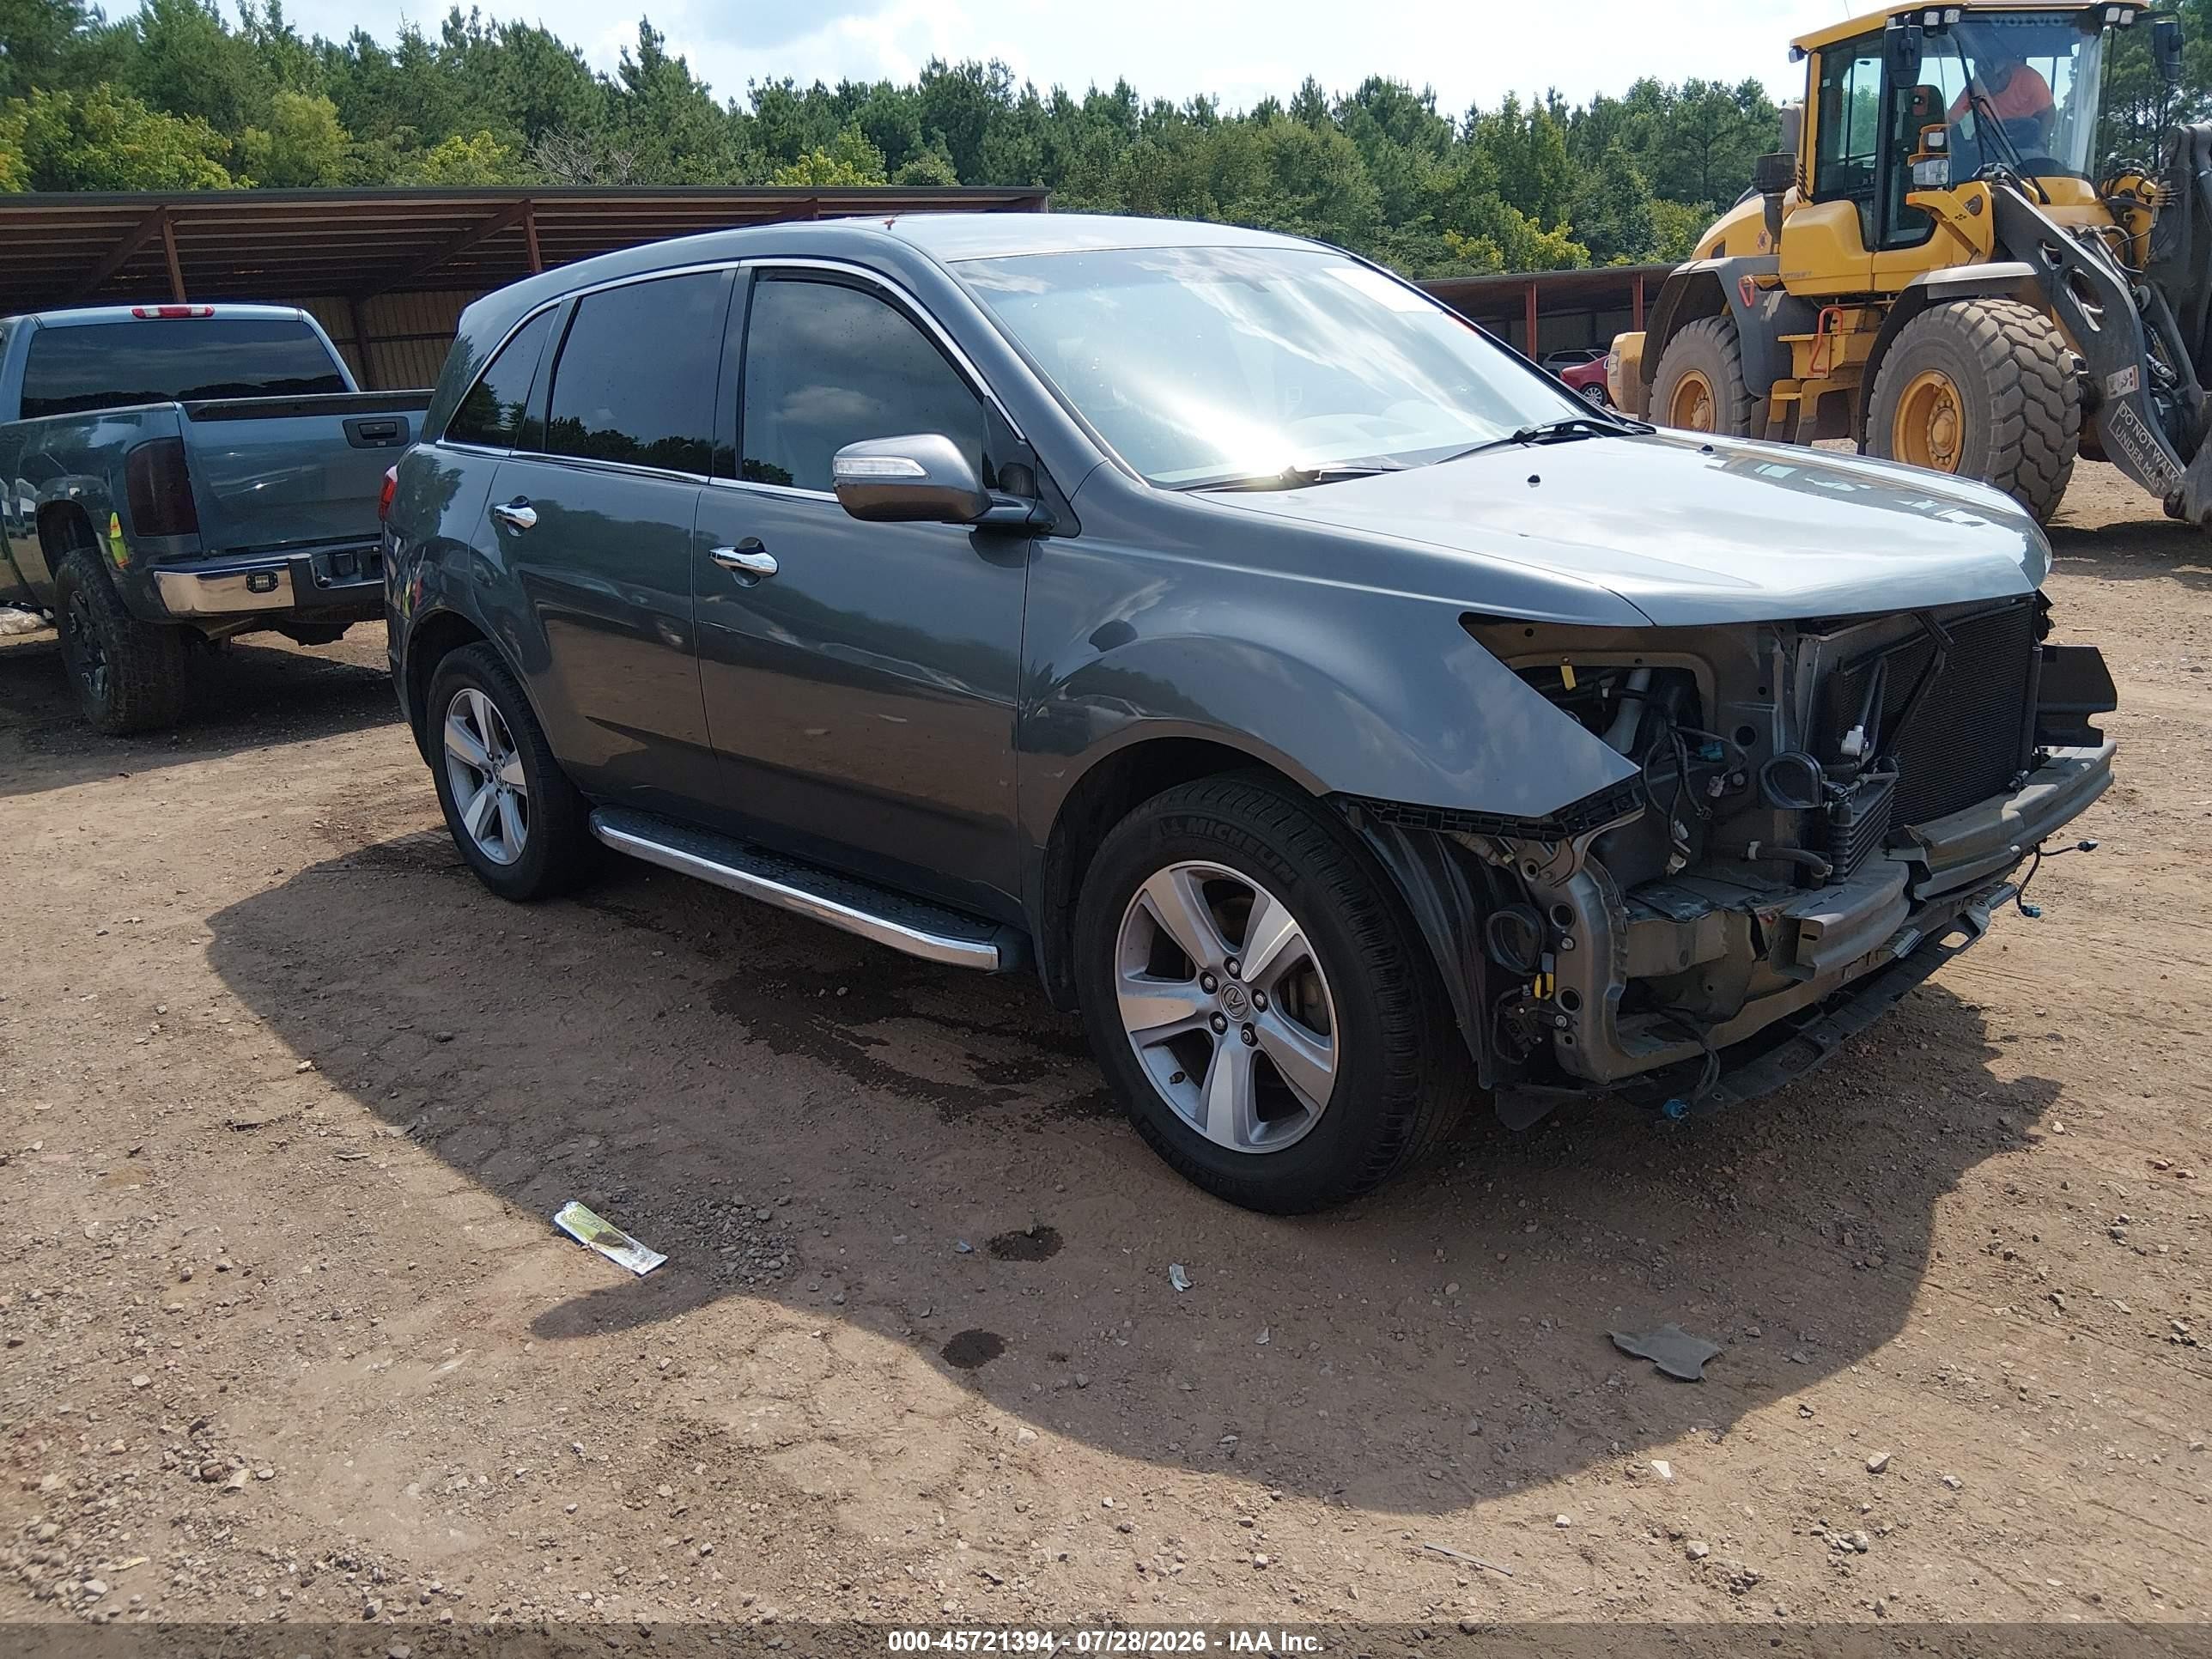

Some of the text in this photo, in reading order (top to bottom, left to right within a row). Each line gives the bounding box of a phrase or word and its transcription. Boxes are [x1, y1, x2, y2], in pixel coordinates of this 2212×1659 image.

[2115, 426, 2166, 489] UNDER MAST
[2118, 406, 2179, 483] DO NOT WALK
[1186, 817, 1300, 884] MICHELIN
